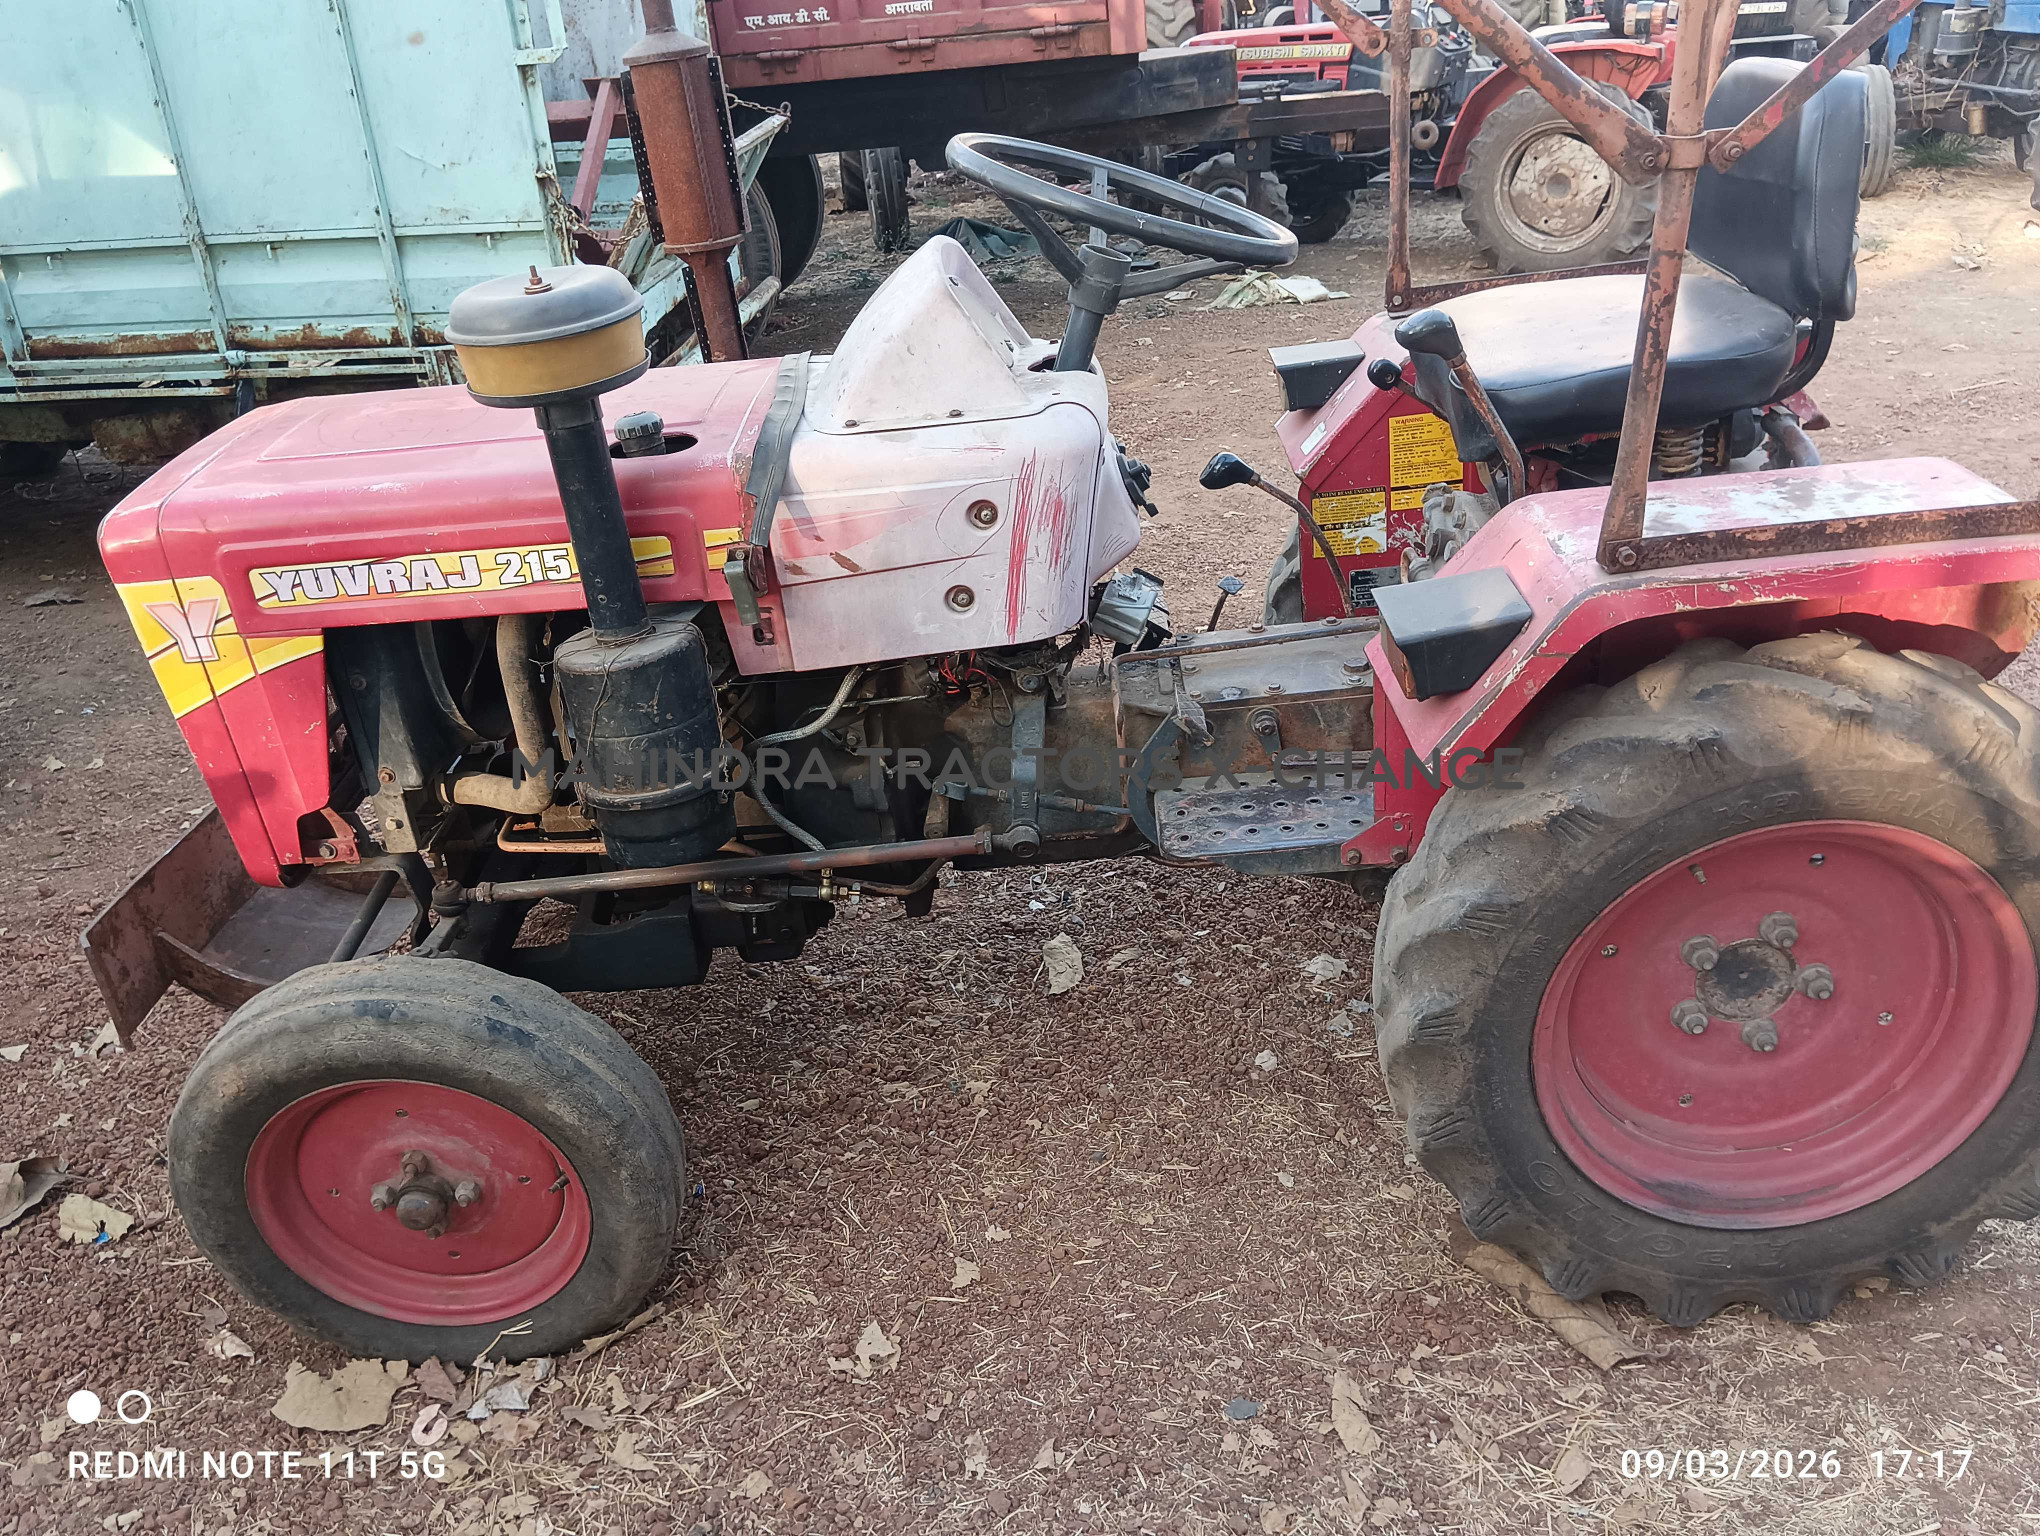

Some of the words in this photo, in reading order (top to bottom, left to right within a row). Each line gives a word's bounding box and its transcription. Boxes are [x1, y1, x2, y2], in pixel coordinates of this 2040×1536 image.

[744, 16, 765, 30] एम.
[795, 8, 811, 23] डी.
[812, 6, 830, 21] सी.
[884, 0, 934, 15] अमरावती
[1300, 45, 1347, 58] SHAKTI
[1394, 416, 1424, 425] WARNING
[260, 555, 483, 602] YUVRAJ
[494, 548, 573, 585] 215
[143, 598, 220, 663] Y
[1527, 1160, 1806, 1269] APOLLO
